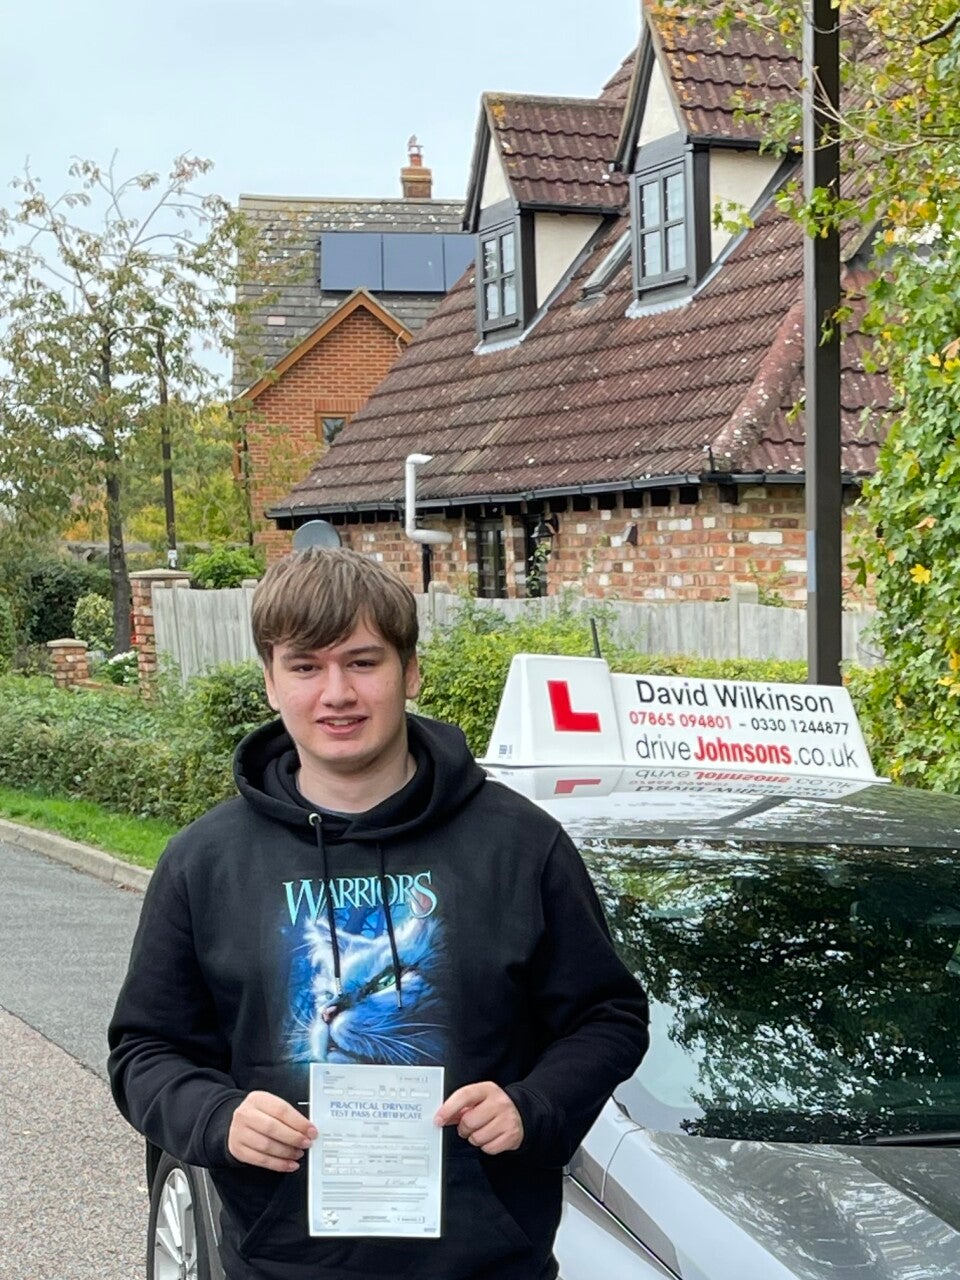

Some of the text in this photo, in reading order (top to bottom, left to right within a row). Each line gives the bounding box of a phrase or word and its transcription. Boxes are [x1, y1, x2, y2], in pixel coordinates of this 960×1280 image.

[547, 680, 602, 733] L
[636, 679, 834, 714] David Wilkinson
[629, 711, 675, 727] 07865
[679, 713, 732, 730] 094801
[751, 717, 786, 733] 0330
[791, 719, 849, 736] 1244877
[635, 733, 859, 769] driveJohnsons.co.uk
[282, 870, 438, 927] WARRIORS
[330, 1101, 422, 1111] PRACTICAL DRIVING
[351, 1110, 371, 1118] PASS
[373, 1110, 422, 1119] CERTIFICATE
